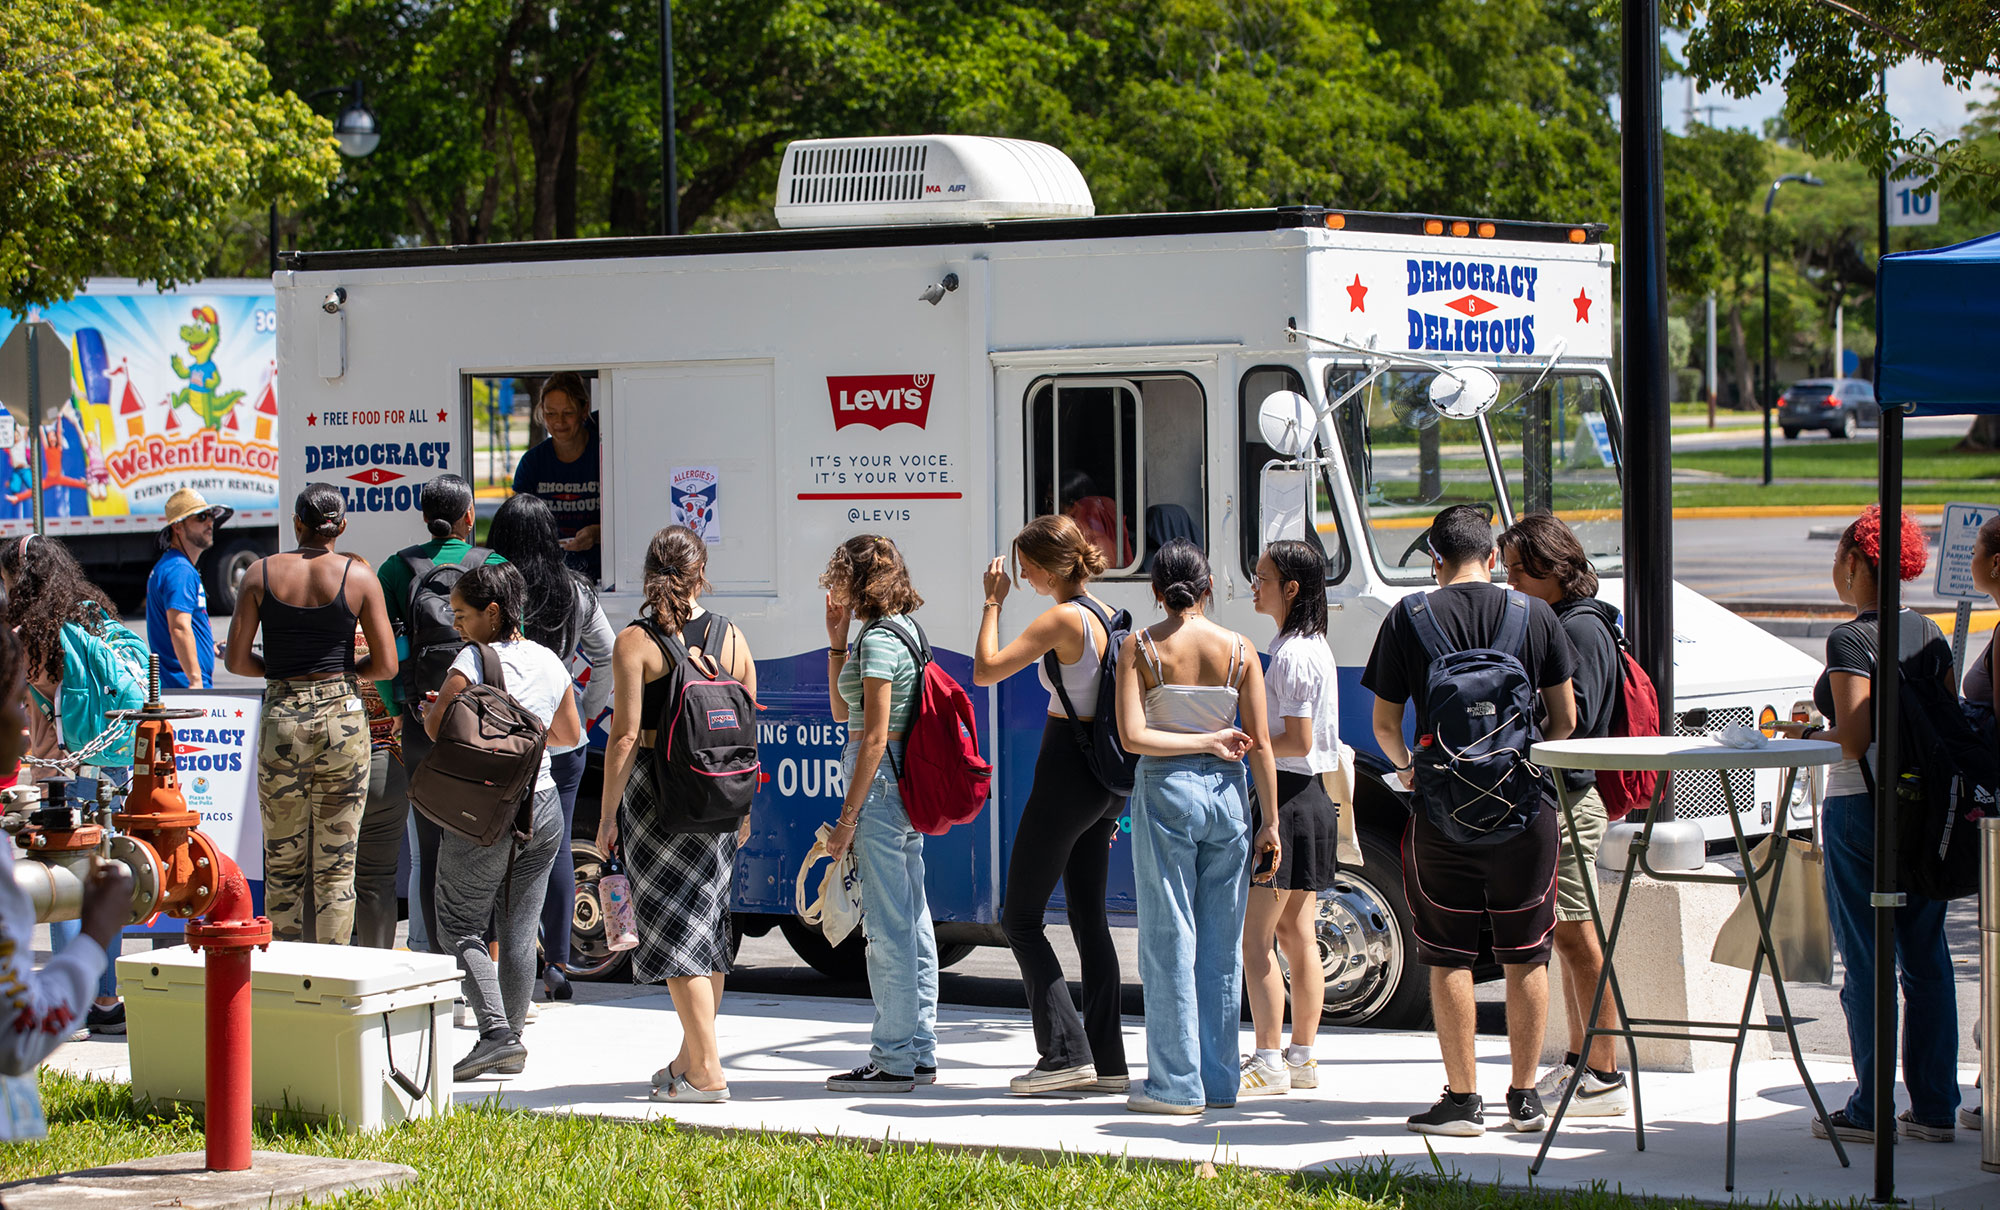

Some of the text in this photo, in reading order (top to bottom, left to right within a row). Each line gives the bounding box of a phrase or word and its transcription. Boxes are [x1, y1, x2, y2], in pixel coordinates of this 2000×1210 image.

[948, 184, 966, 193] AIR
[1896, 187, 1932, 215] 10
[1406, 259, 1538, 302] DEMOCRACY
[1468, 298, 1476, 312] IS
[1407, 308, 1536, 355] DELICIOUS
[323, 408, 428, 426] FREE FOOD FOR ALL
[305, 442, 450, 474] DEMOCRACY
[810, 454, 954, 467] IT'S YOUR VOICE.
[372, 471, 380, 482] IS
[674, 469, 715, 483] ALLERGIES?
[815, 471, 955, 484] IT'S YOUR VOTE.
[134, 481, 176, 500] EVENTS
[191, 478, 224, 489] PARTY
[228, 477, 275, 494] RENTALS
[847, 508, 911, 523] @LEVIS
[1946, 552, 1974, 560] PARKIN
[1951, 574, 1973, 582] WILLIA
[1950, 582, 1974, 590] MURPH
[211, 708, 227, 718] ALL
[174, 729, 245, 746] CRACY
[757, 724, 846, 746] ING QUES
[176, 752, 243, 772] CIOUS
[777, 757, 844, 798] OUR
[200, 812, 233, 821] TACOS
